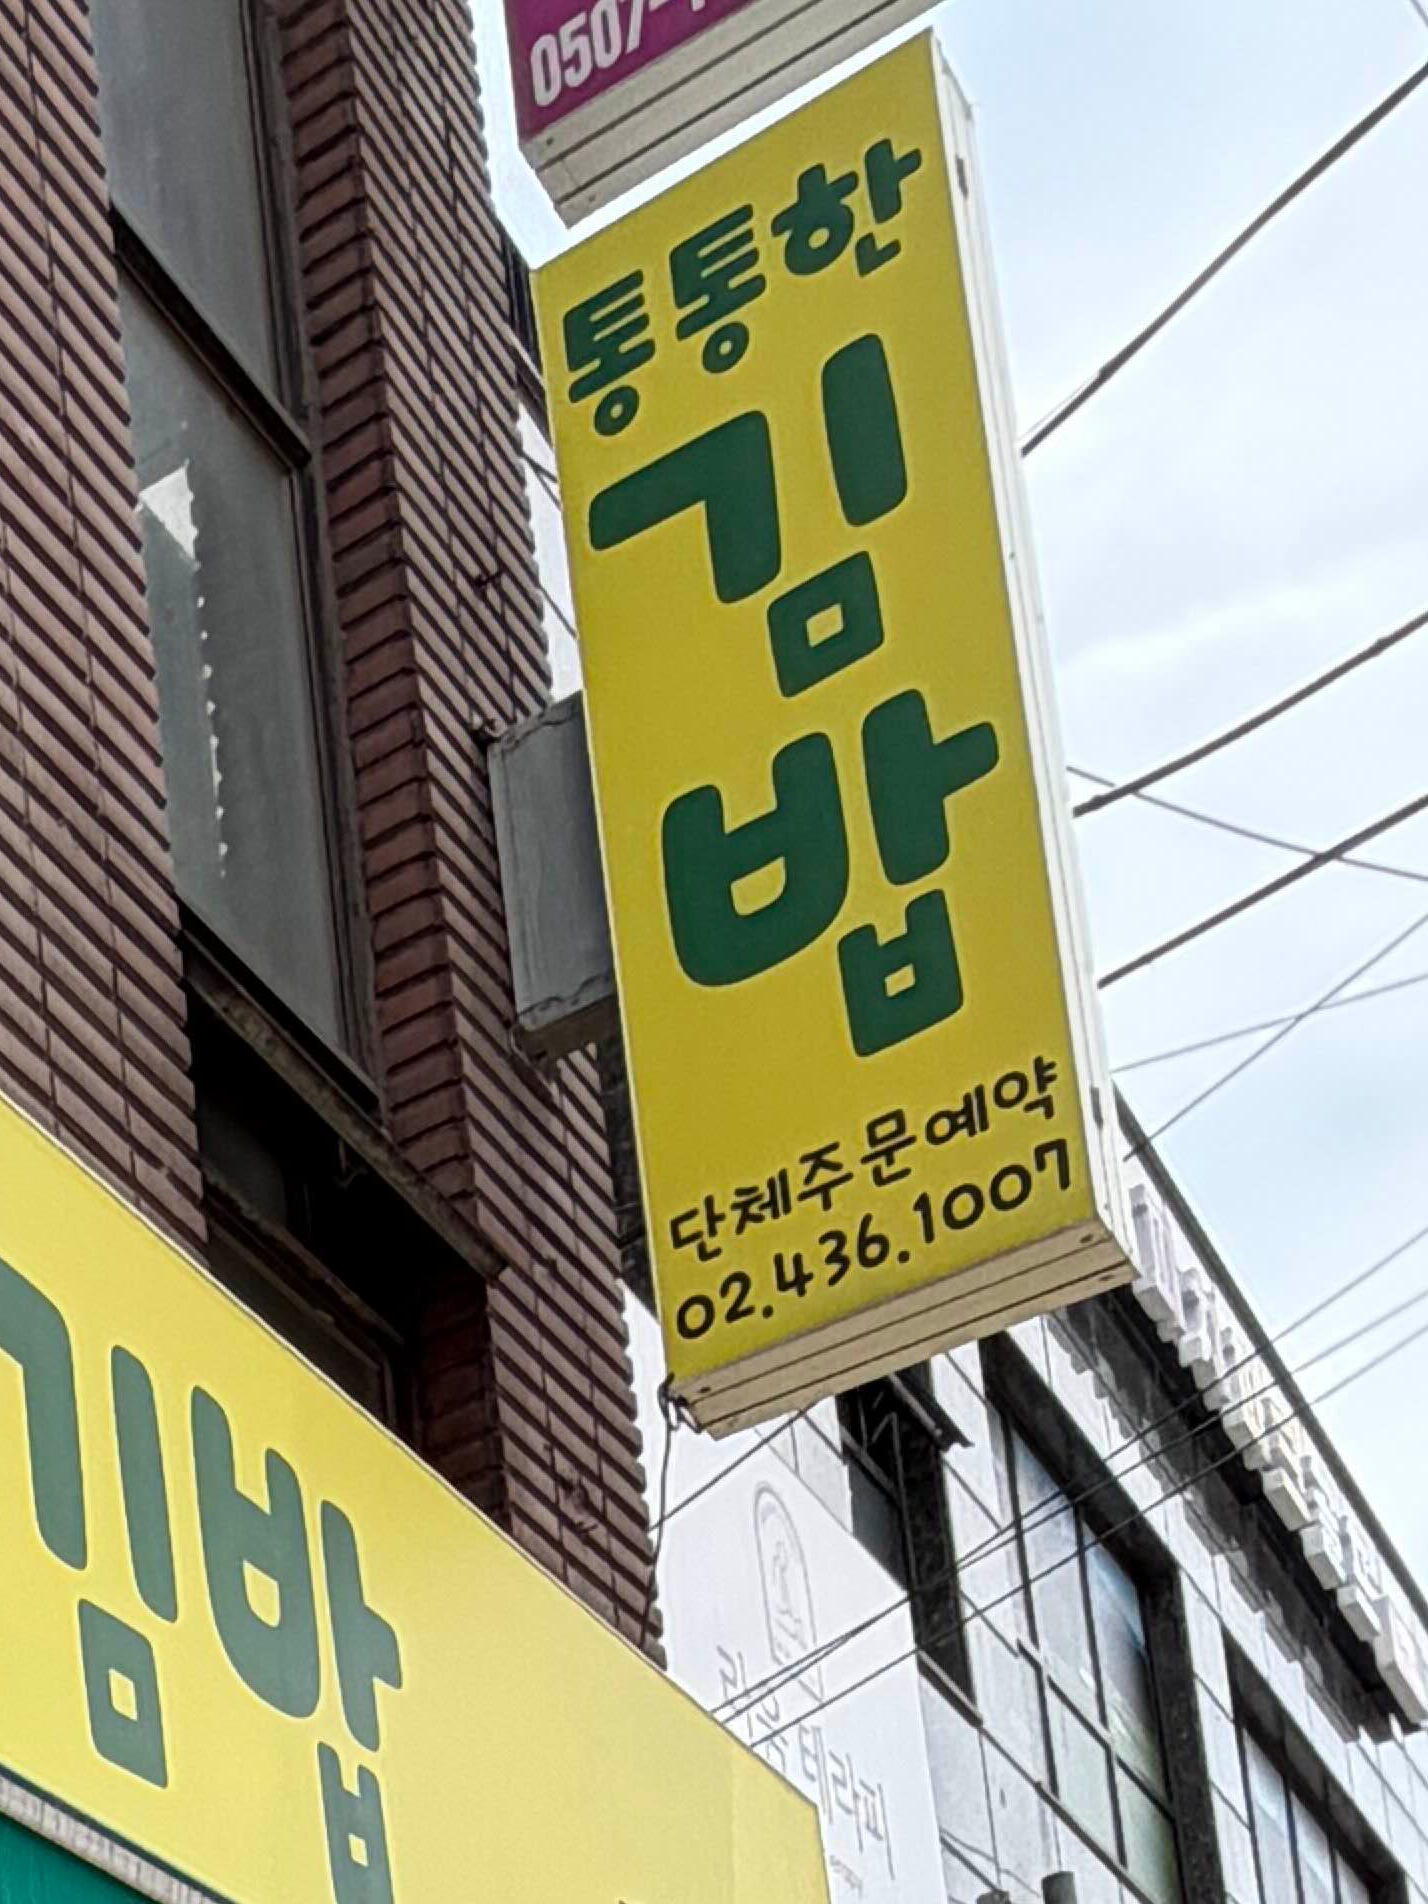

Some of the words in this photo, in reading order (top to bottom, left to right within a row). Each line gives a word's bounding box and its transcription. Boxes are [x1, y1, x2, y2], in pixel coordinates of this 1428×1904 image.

[562, 137, 923, 437] 통통한
[587, 331, 1000, 1057] 김밥
[668, 1056, 1057, 1260] 단체주문예약
[675, 1138, 1074, 1342] 02.436.1007
